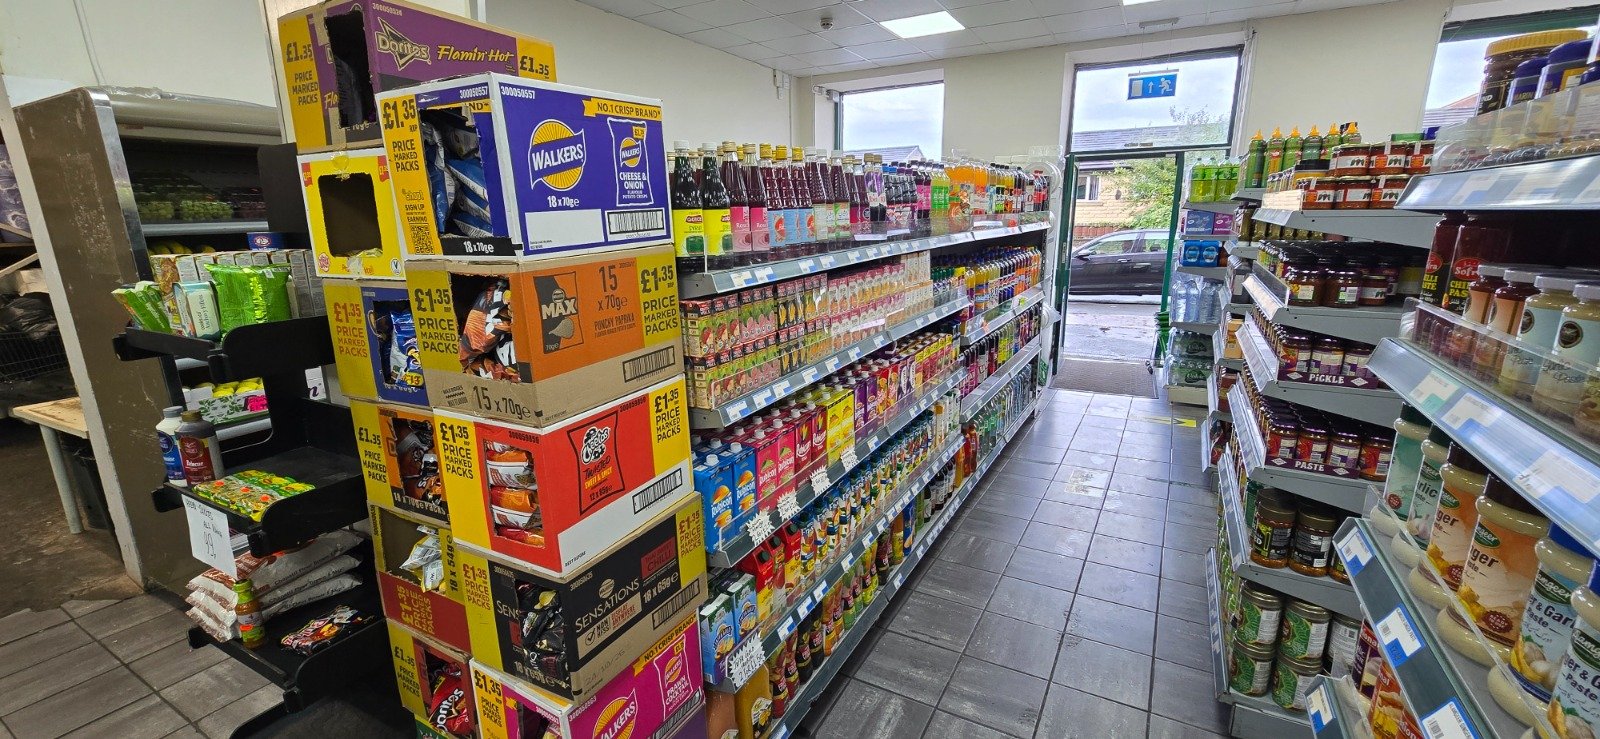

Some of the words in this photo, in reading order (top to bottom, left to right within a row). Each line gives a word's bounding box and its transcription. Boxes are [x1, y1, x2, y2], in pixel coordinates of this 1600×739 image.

[286, 41, 313, 63] £1.35
[377, 34, 431, 60] Doritos
[487, 50, 515, 62] Hot
[519, 56, 550, 76] £1.35
[294, 70, 313, 83] PRICE
[292, 82, 319, 95] MARKED
[298, 94, 318, 106] PACKS
[382, 98, 416, 130] £1.35
[614, 104, 634, 115] CRISP
[392, 139, 415, 152] PRICE
[394, 152, 418, 161] MARKED
[532, 144, 584, 172] WALKERS
[395, 161, 420, 172] PACKS
[619, 172, 641, 180] CHEESE
[624, 181, 644, 189] ONION
[598, 265, 618, 292] 15
[641, 264, 674, 294] £1.35
[414, 288, 450, 312] £1.35
[542, 298, 577, 320] MAX
[643, 295, 676, 313] PRICE
[333, 302, 361, 323] £1.35
[644, 308, 677, 323] MARKED
[419, 318, 454, 331] PRICE
[594, 317, 614, 331] PUNCHY
[614, 313, 635, 326] PAPRIKA
[645, 318, 678, 336] PACKS
[336, 326, 364, 339] PRICE
[420, 332, 456, 342] MARKED
[338, 337, 366, 347] MARKED
[423, 342, 458, 354] PACKS
[339, 346, 368, 358] PACKS
[473, 386, 492, 411] 15
[495, 400, 502, 412] x
[654, 388, 678, 414] £1.35
[656, 406, 680, 426] PRICE
[440, 422, 469, 444] £1.35
[656, 418, 680, 433] MARKED
[657, 425, 680, 443] PACKS
[358, 426, 381, 447] £1.35
[364, 450, 381, 462] PRICE
[443, 445, 471, 459] PRICE
[363, 459, 387, 473] MARKED
[444, 456, 472, 469] MARKED
[778, 456, 794, 473] Rubicon
[1294, 461, 1325, 472] PASTE
[368, 470, 387, 484] PACKS
[446, 464, 474, 480] PACKS
[760, 468, 776, 486] Rubicon
[737, 481, 756, 500] Rubicon
[711, 495, 733, 518] Rubicon
[678, 510, 700, 534] £1.35
[680, 525, 701, 542] PRICE
[680, 533, 701, 550] MARKED
[680, 541, 702, 558] PACKS
[463, 564, 487, 582] £1.35
[465, 579, 489, 595] PRICE
[467, 589, 490, 600] MARKED
[397, 584, 414, 626] £1.35
[468, 595, 491, 610] PACKS
[575, 578, 640, 633] SENSATIONS
[1527, 607, 1548, 628] Paste
[658, 632, 675, 650] CRISP
[394, 646, 415, 667] £1.35
[399, 665, 414, 678] PRICE
[666, 658, 682, 681] WALKERS
[398, 672, 420, 690] MARKED
[402, 683, 420, 697] PACKS
[474, 670, 501, 696] £1.35
[667, 675, 686, 696] PRAWN
[1566, 673, 1598, 701] Paste
[666, 681, 689, 705] COCKTAIL
[481, 696, 499, 711] PRICE
[483, 709, 502, 727] PACKS
